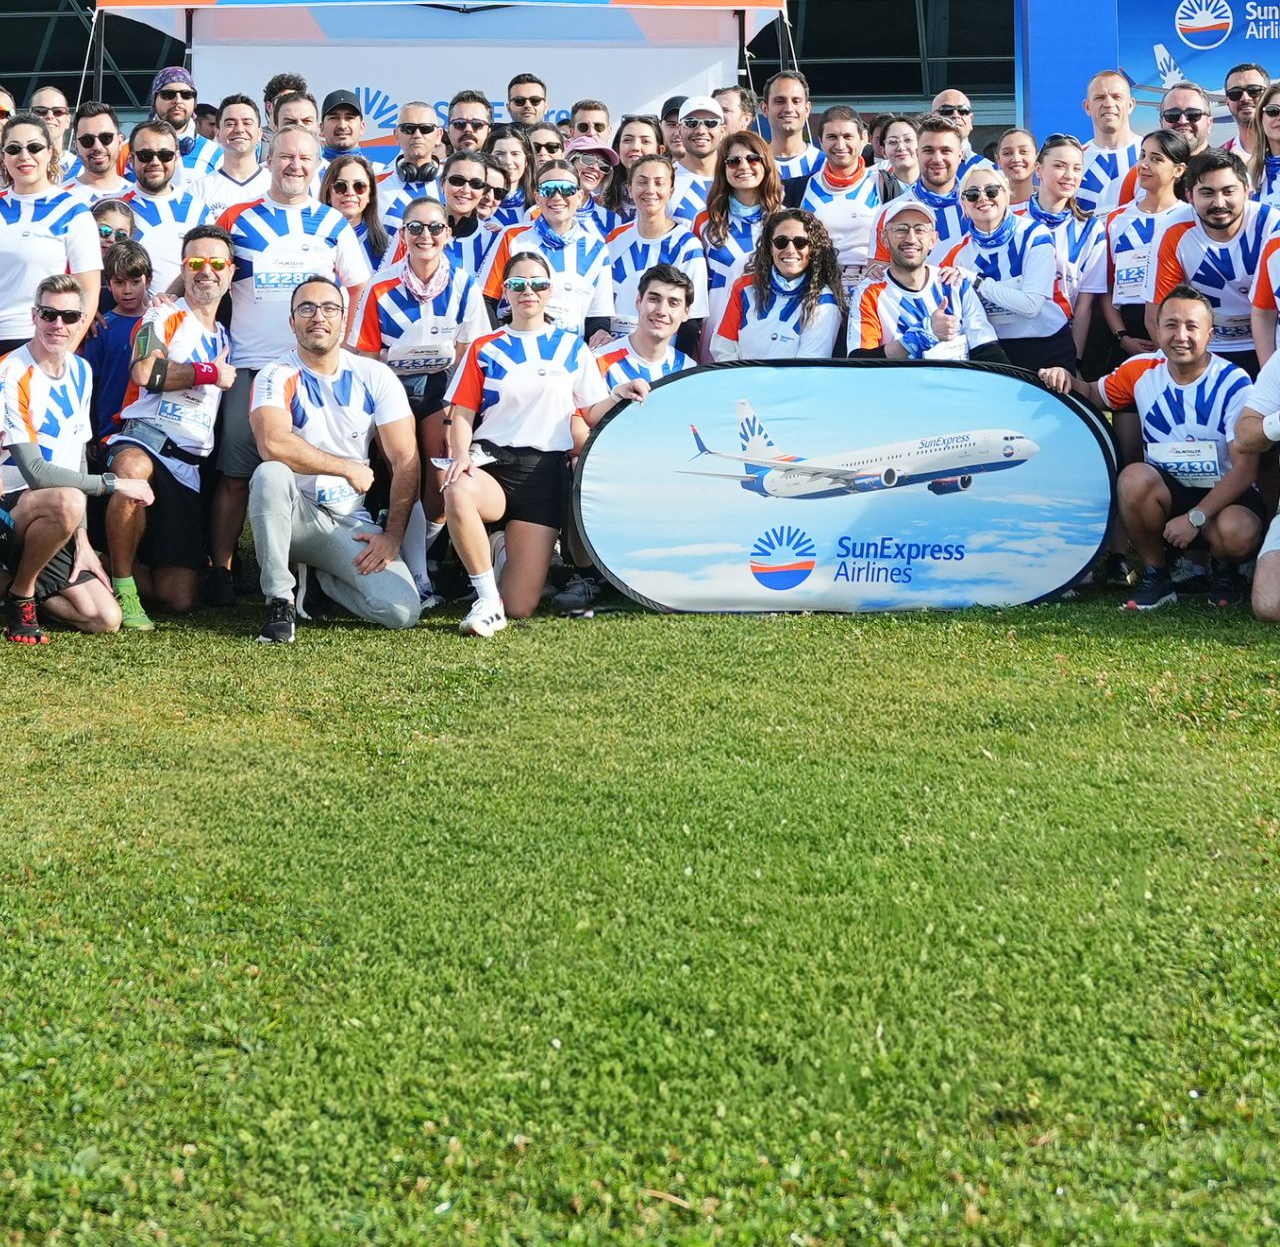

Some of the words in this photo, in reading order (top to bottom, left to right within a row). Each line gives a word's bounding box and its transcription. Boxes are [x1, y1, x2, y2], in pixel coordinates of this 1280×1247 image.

[919, 433, 970, 450] SunExpress
[837, 536, 966, 565] SunExpress
[834, 561, 912, 584] Airlines
